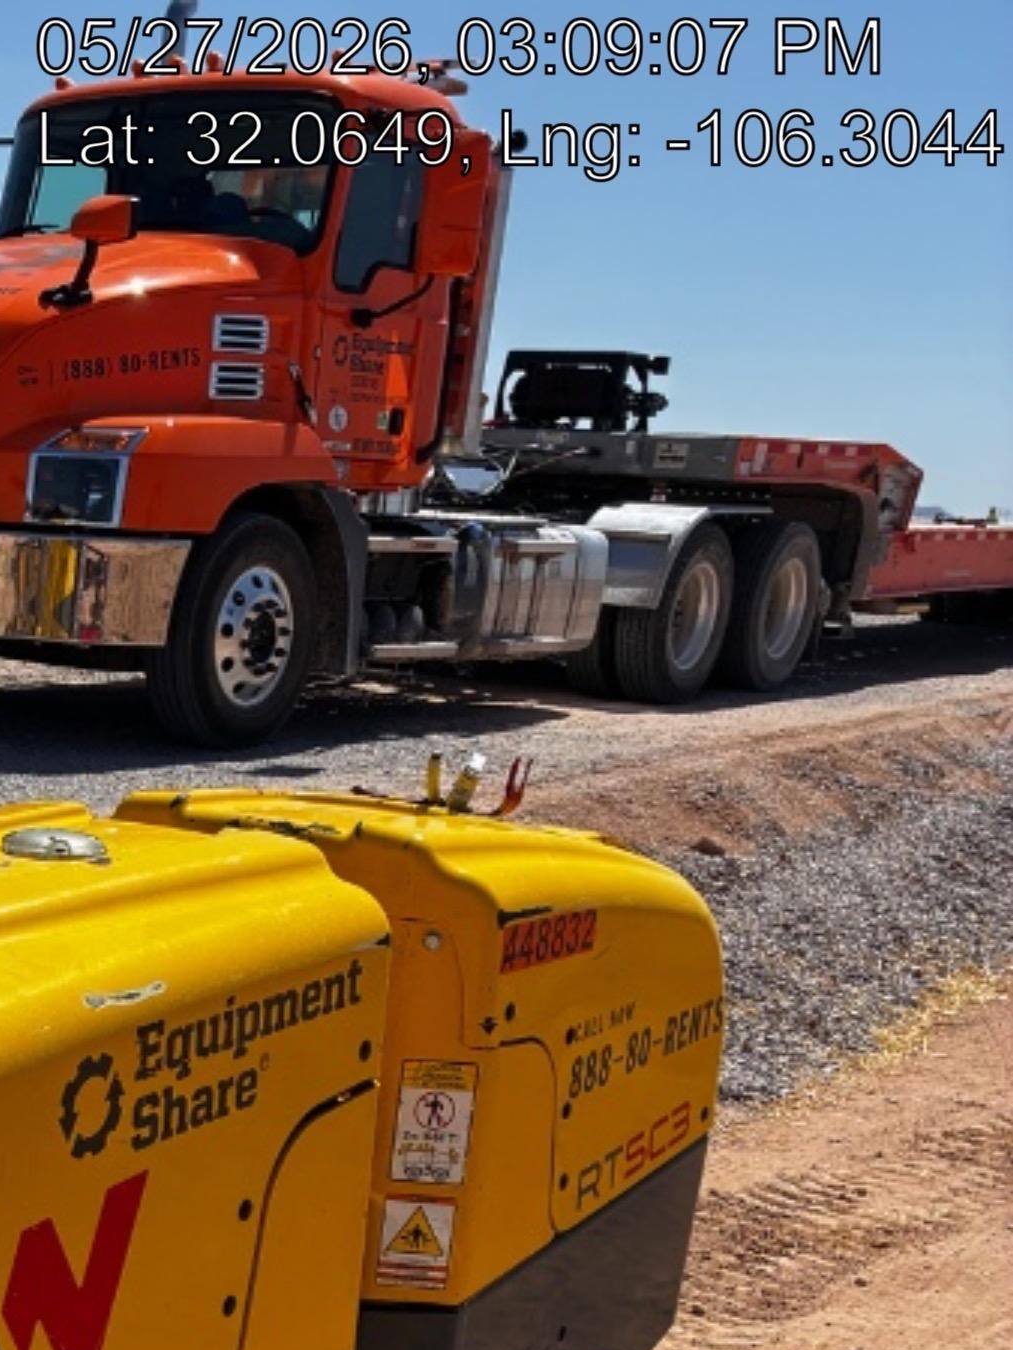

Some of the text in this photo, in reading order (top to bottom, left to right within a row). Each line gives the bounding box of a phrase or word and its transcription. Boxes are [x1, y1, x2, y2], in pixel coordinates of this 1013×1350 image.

[62, 357, 113, 381] (888)
[501, 911, 597, 971] 448832
[135, 959, 363, 1081] Equipment
[568, 996, 723, 1099] 888-80-RENTS
[131, 1066, 259, 1151] Share
[575, 1101, 692, 1210] RTSC3
